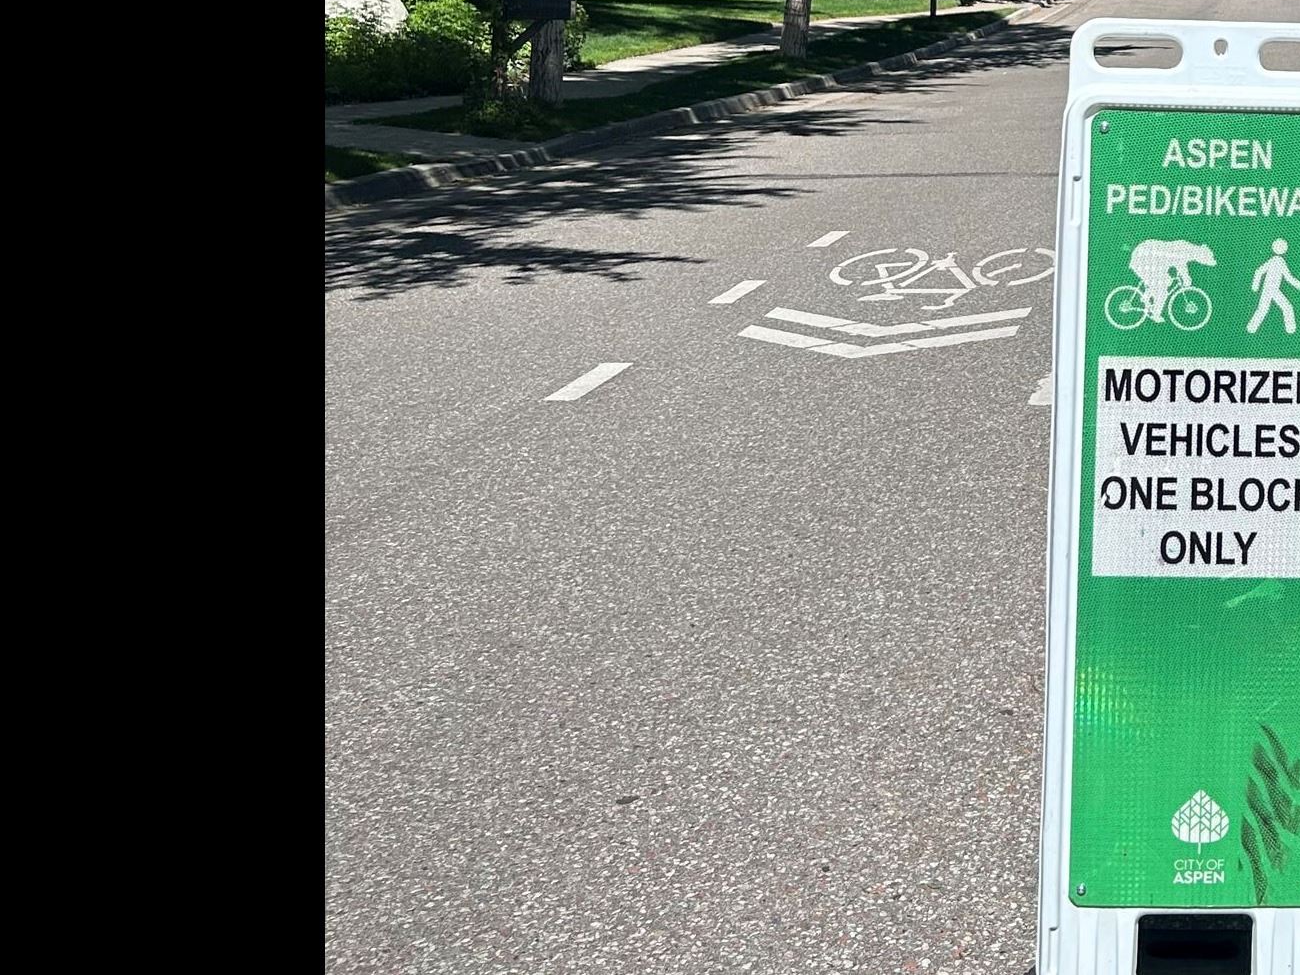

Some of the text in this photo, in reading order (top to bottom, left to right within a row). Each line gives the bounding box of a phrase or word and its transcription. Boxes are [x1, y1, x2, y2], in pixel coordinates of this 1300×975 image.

[1162, 138, 1273, 170] ASPEN
[1120, 422, 1300, 458] VEHICLES
[1100, 475, 1178, 510] ONE
[1160, 531, 1257, 565] ONLY
[1172, 871, 1225, 884] ASPEN
[1173, 859, 1225, 870] CITY OF
